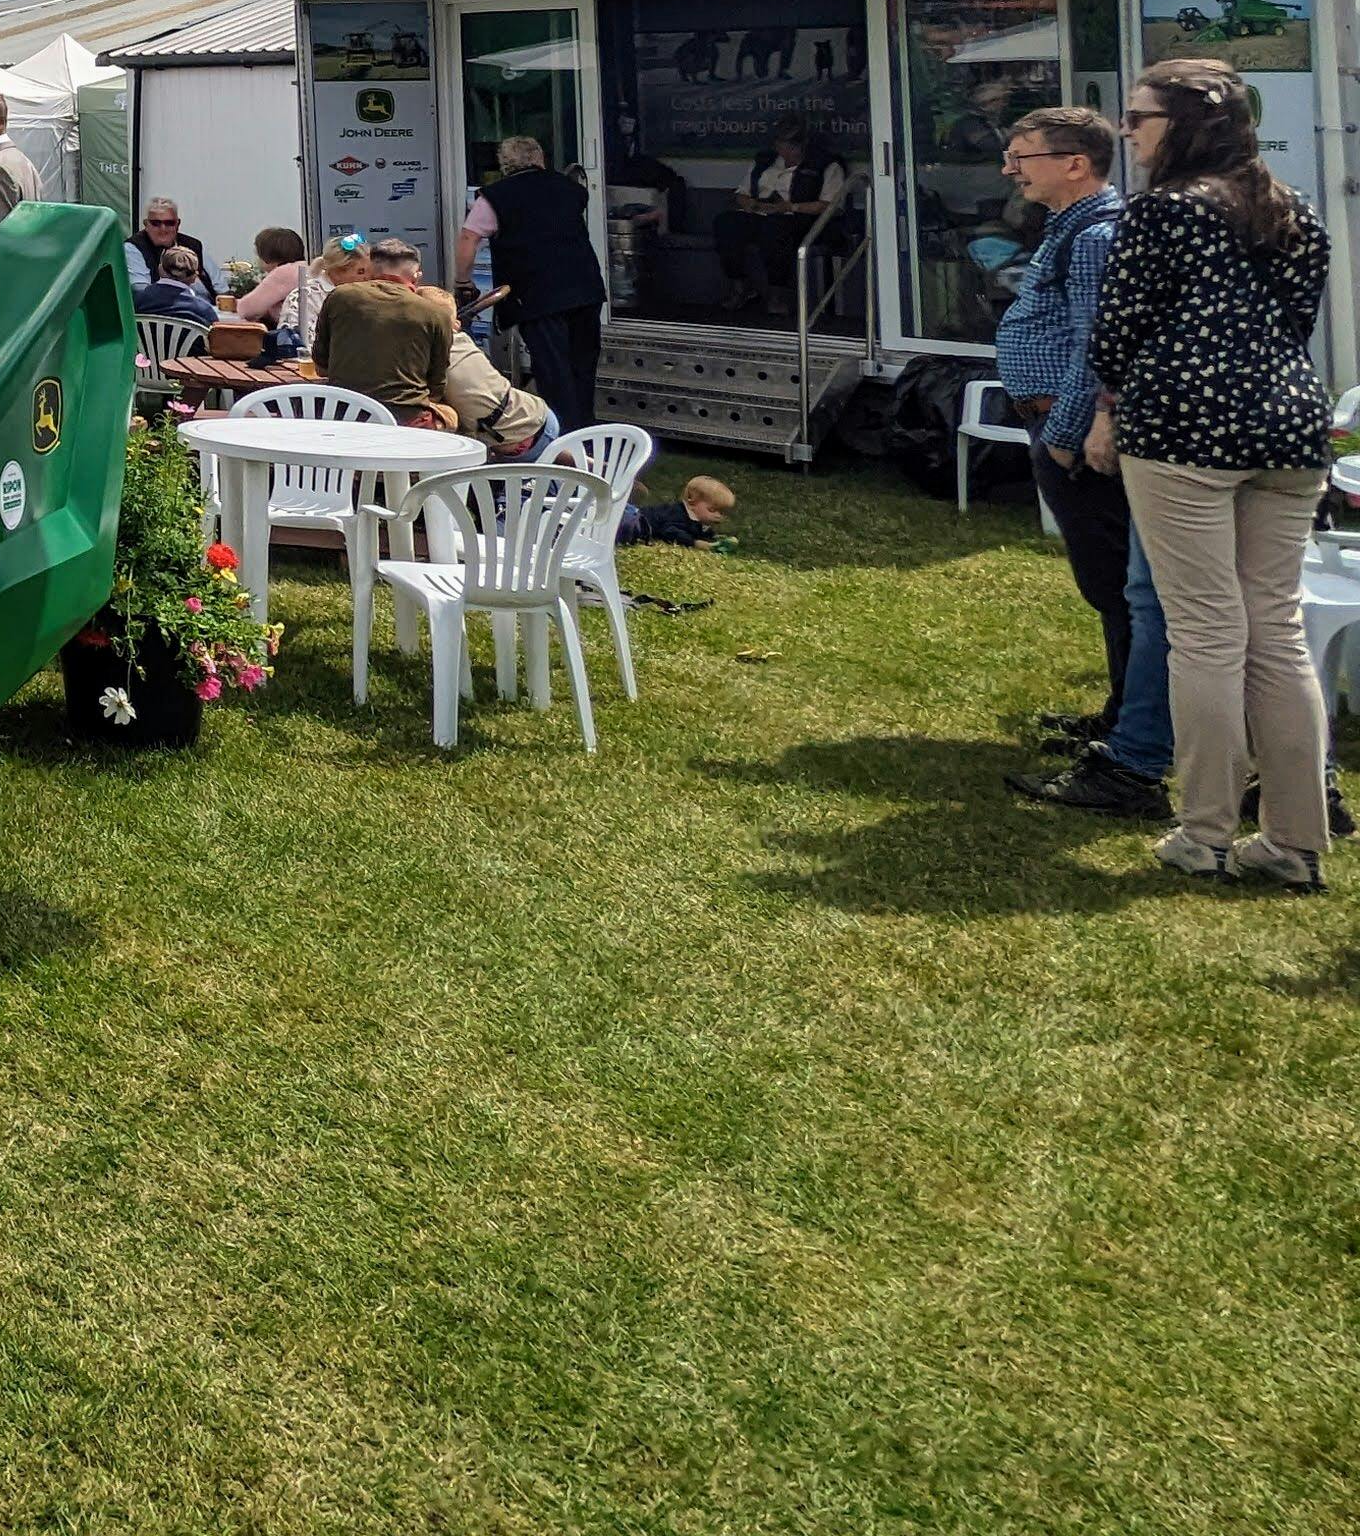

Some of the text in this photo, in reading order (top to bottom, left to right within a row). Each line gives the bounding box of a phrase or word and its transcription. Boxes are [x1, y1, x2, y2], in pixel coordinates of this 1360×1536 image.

[721, 95, 753, 111] less
[757, 93, 799, 111] than
[339, 128, 414, 138] JOHN DEERE
[99, 162, 119, 174] THE
